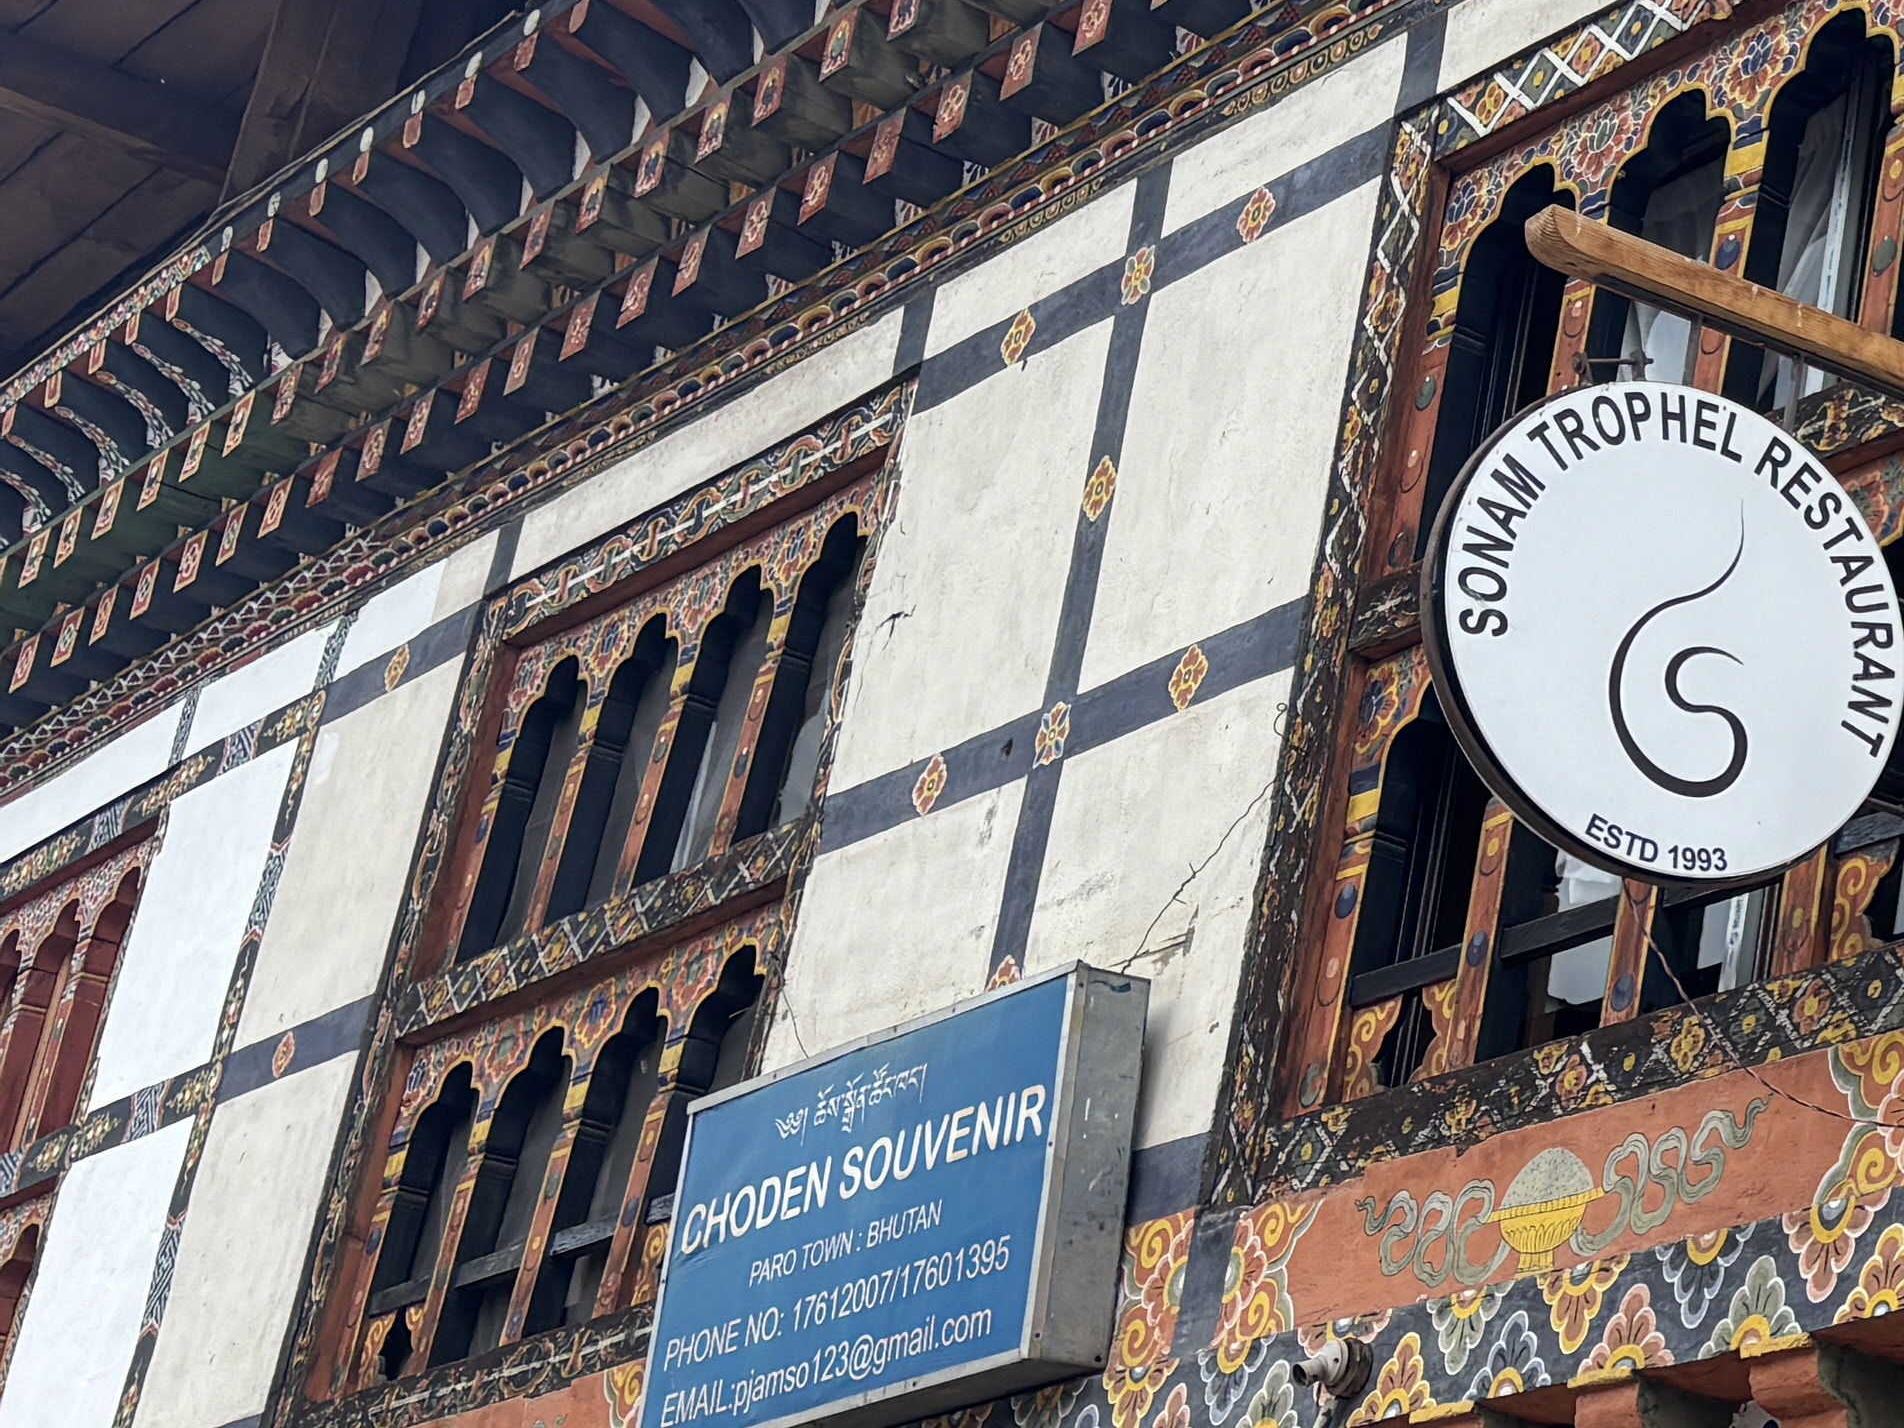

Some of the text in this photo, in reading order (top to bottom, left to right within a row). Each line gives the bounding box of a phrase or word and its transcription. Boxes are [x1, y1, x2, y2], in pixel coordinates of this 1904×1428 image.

[1458, 391, 1895, 759] SONAM TROPHEL RESTAURANT
[1585, 813, 1728, 872] ESTD 1993
[681, 1084, 1046, 1255] CHODEN SOUVENIR
[664, 1235, 1011, 1371] PHONE NO: 17612007/17601395
[749, 1248, 797, 1288] PARO
[801, 1233, 854, 1266] TOWN
[866, 1200, 943, 1249] BHUTAN
